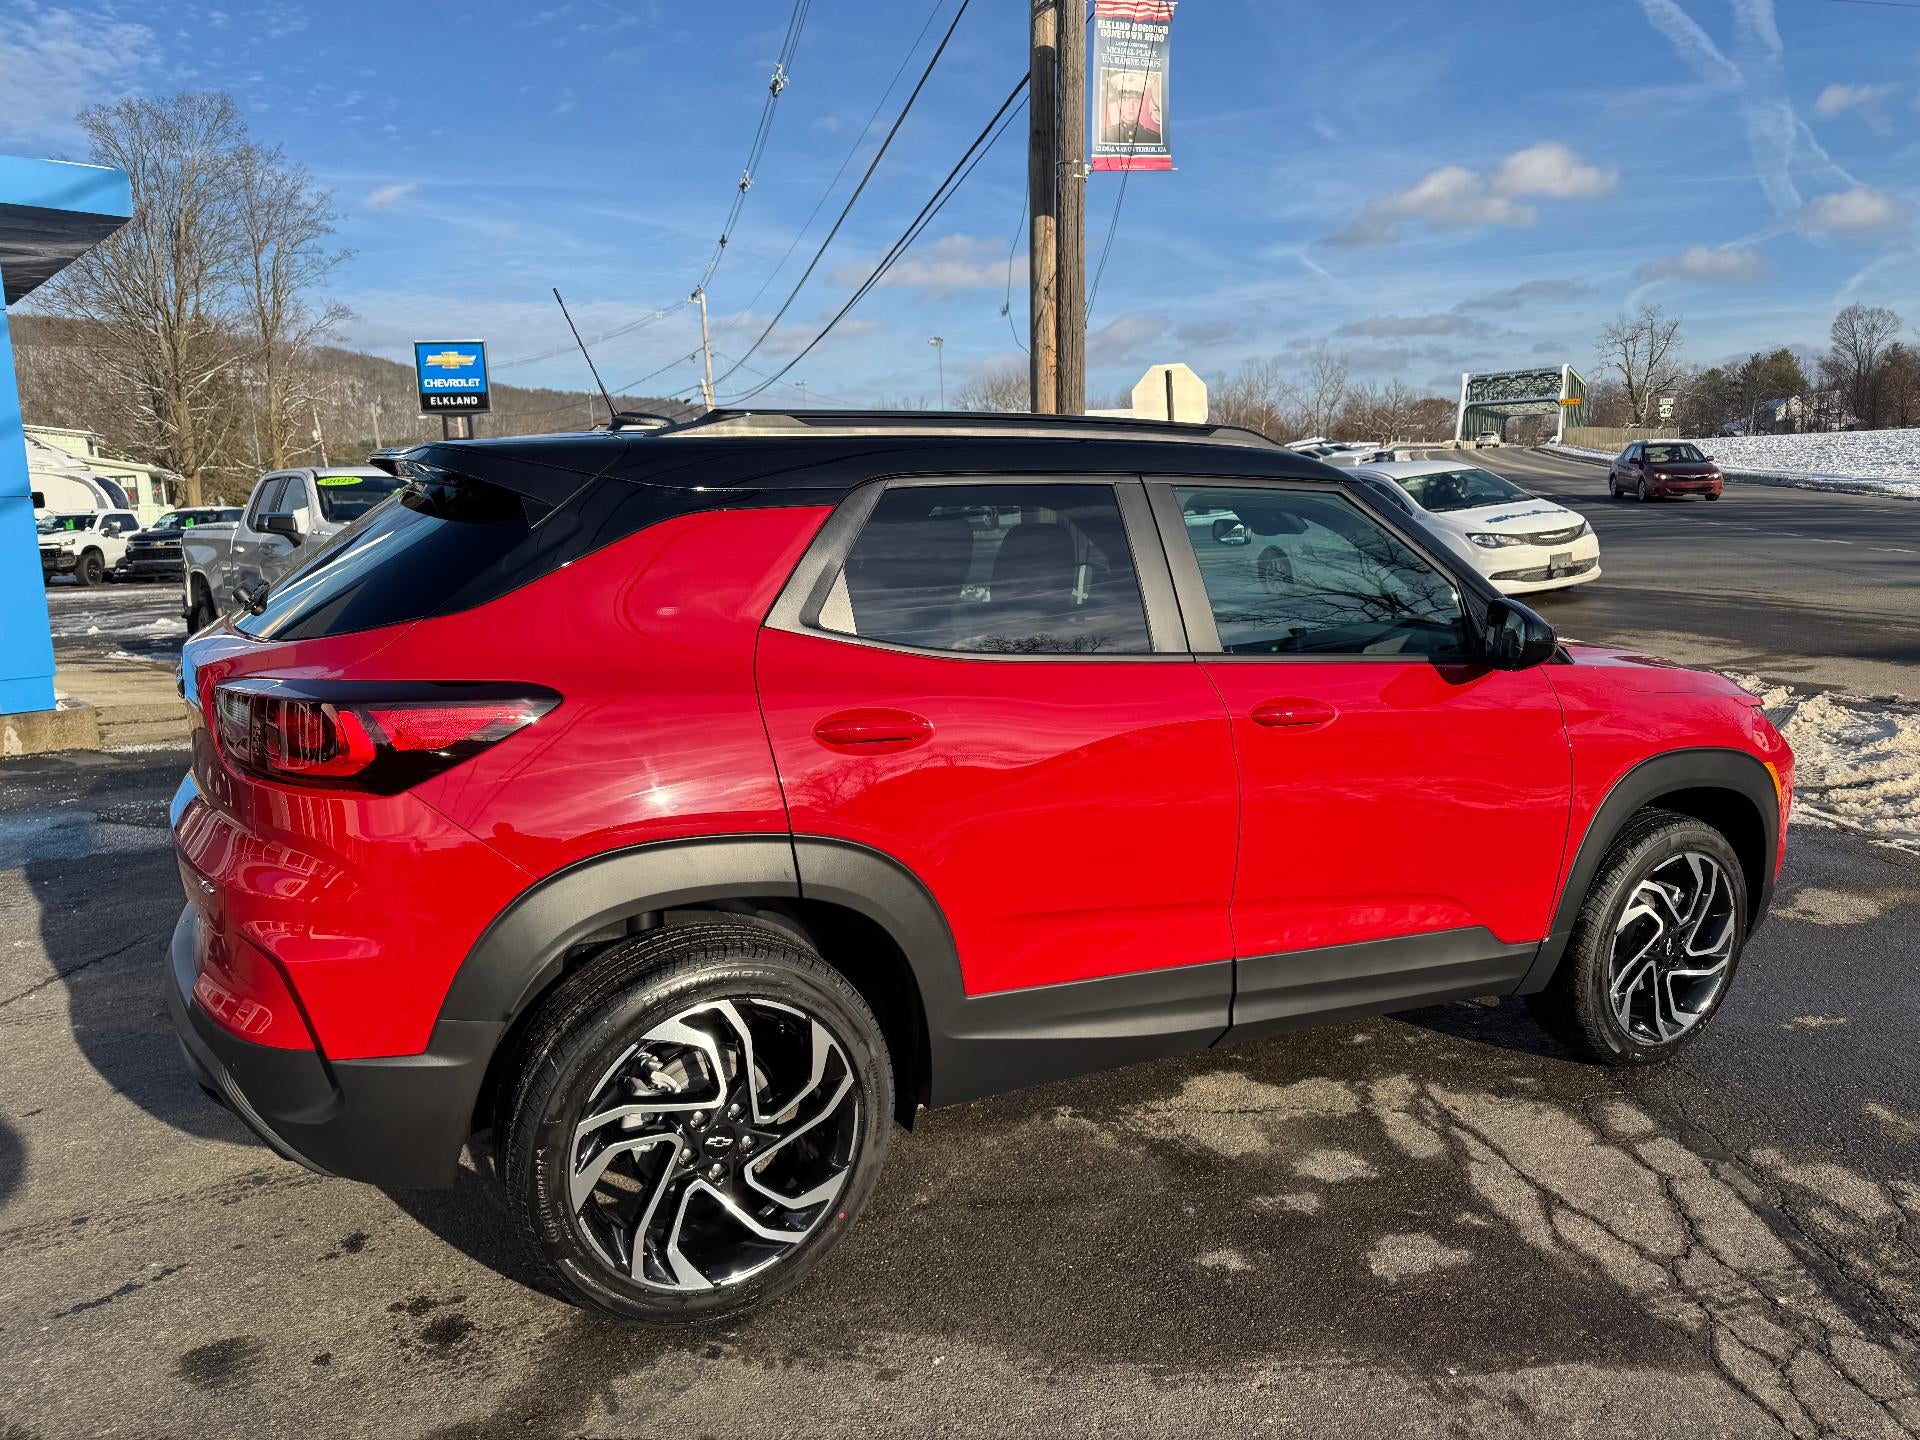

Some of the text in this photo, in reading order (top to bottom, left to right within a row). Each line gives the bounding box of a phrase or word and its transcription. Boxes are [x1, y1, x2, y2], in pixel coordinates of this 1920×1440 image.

[1097, 20, 1169, 34] ELKLAND BOROUGH
[1101, 28, 1165, 42] HOMETOWN HERO
[1114, 57, 1140, 66] MARINE
[424, 378, 480, 388] CHEVROLET
[430, 396, 478, 406] ELKLAND
[1661, 407, 1671, 415] 49
